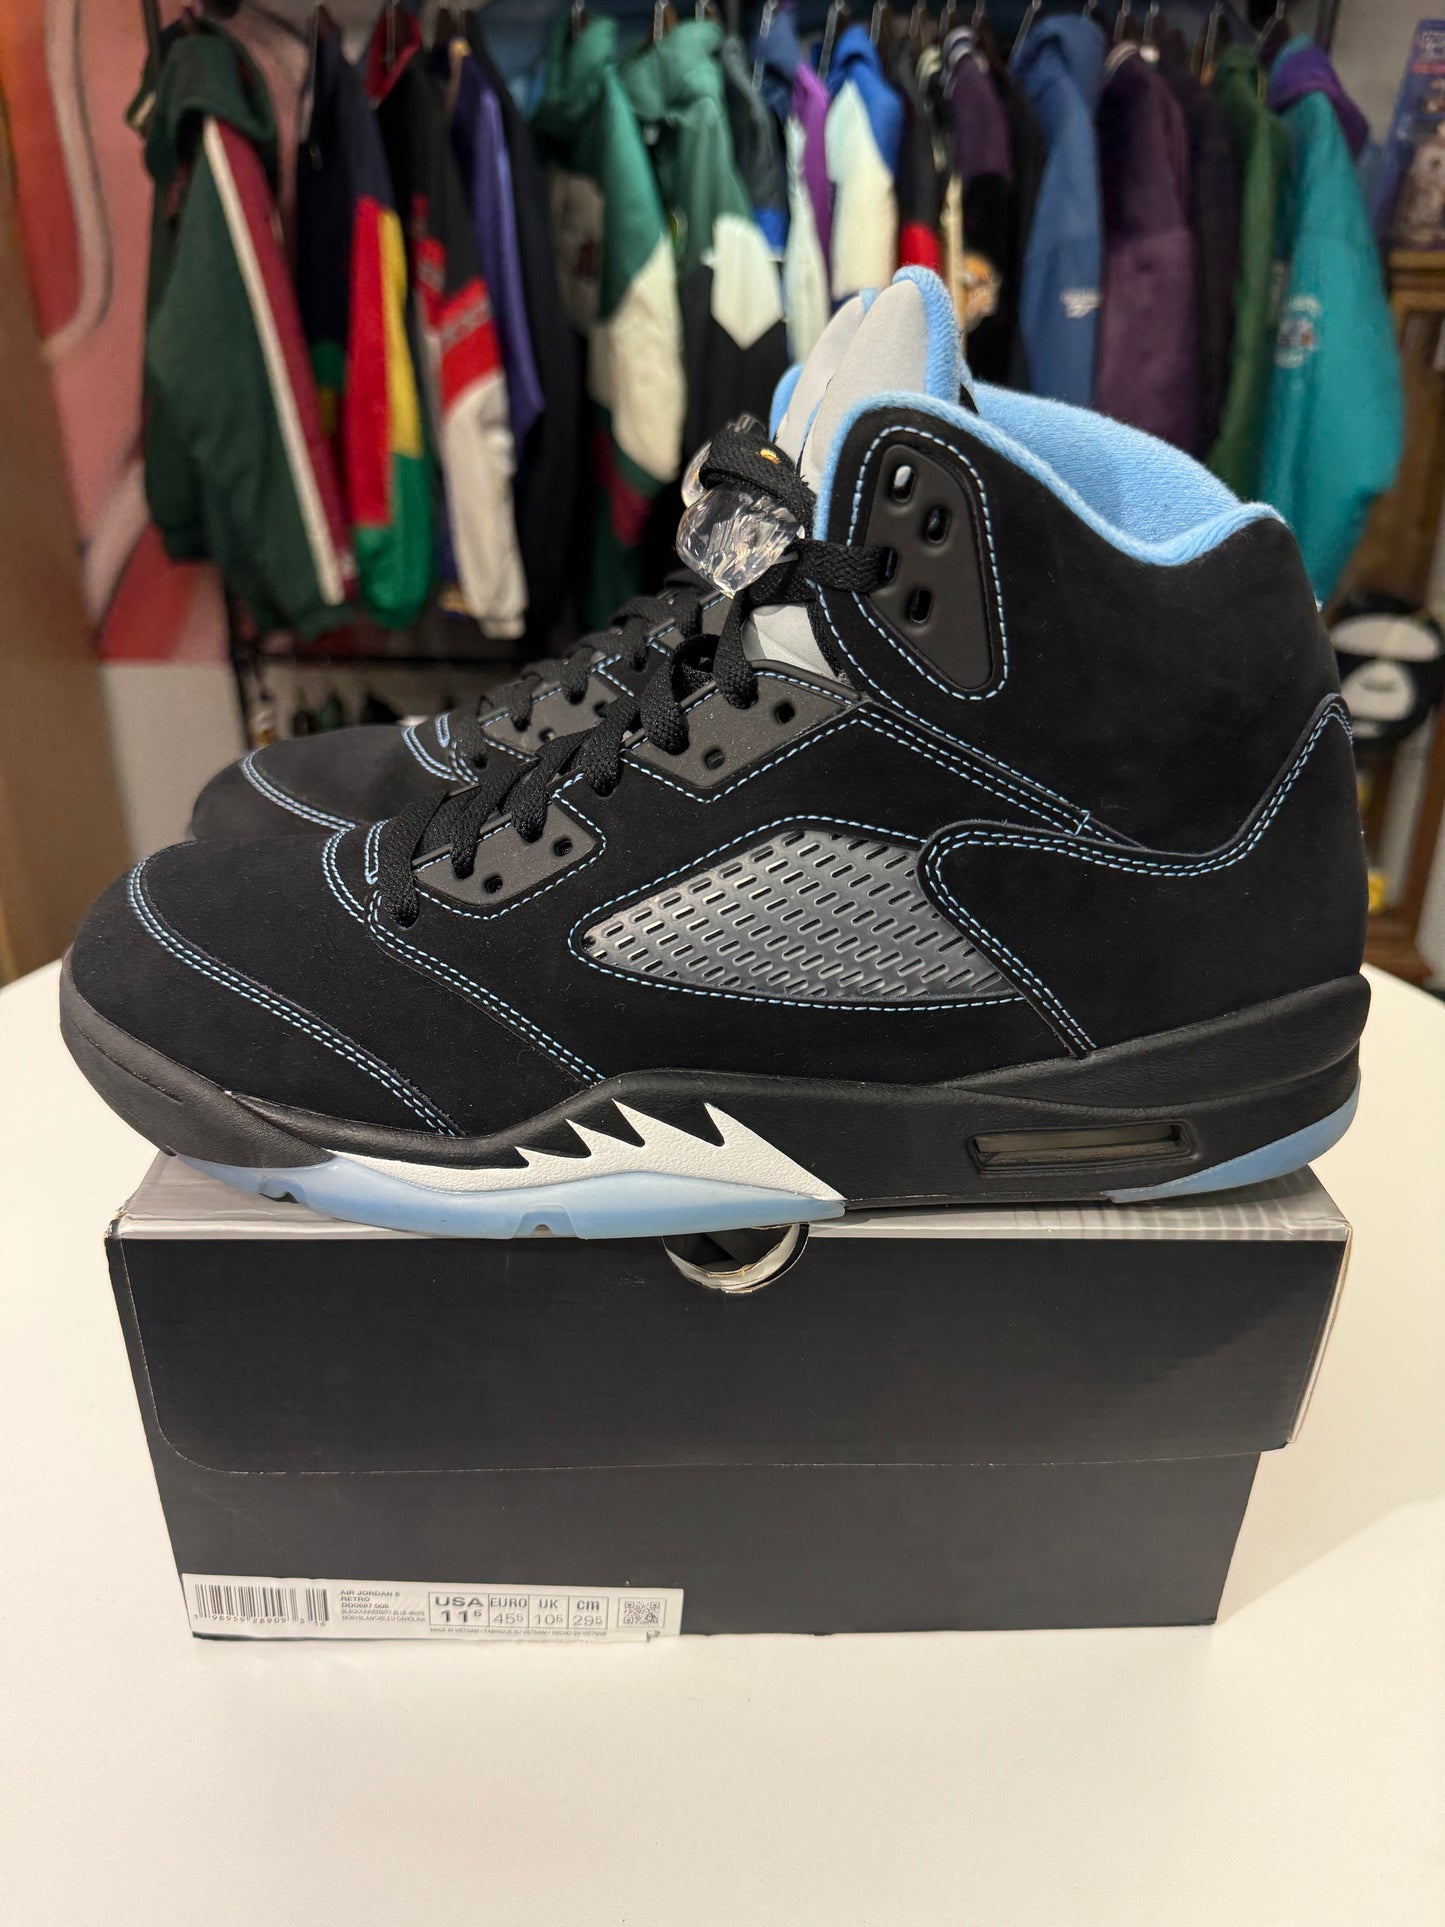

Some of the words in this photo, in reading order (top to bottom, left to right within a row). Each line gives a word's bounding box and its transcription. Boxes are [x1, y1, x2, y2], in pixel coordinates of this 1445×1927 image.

[435, 1596, 484, 1607] USA
[490, 1597, 528, 1608] EURO
[539, 1598, 558, 1609] UK
[576, 1600, 600, 1610] cm
